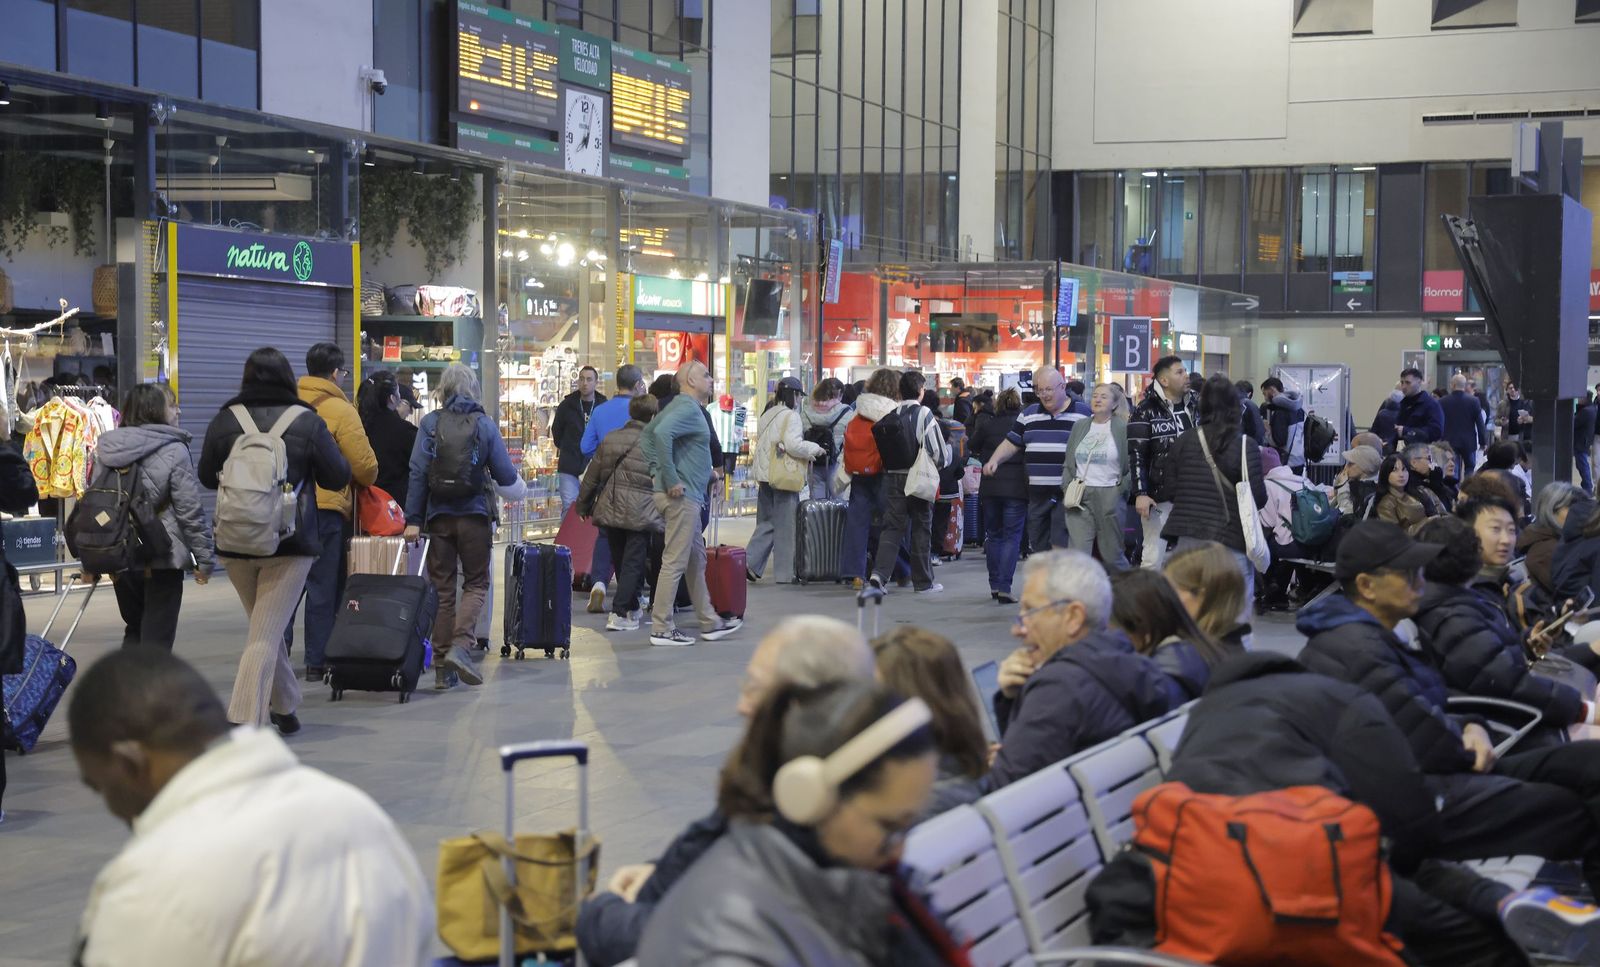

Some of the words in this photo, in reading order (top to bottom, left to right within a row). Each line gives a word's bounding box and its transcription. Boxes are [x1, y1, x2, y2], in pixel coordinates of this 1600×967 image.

[572, 38, 588, 57] TRENES
[589, 43, 600, 60] ALTA
[574, 56, 598, 76] VELOCIDAD
[581, 101, 589, 113] 12
[568, 132, 574, 144] 9
[594, 138, 600, 149] 3
[227, 242, 290, 272] natura
[1424, 286, 1463, 297] flormar
[659, 338, 680, 362] 19
[1125, 335, 1141, 368] B
[23, 536, 42, 545] tiendas
